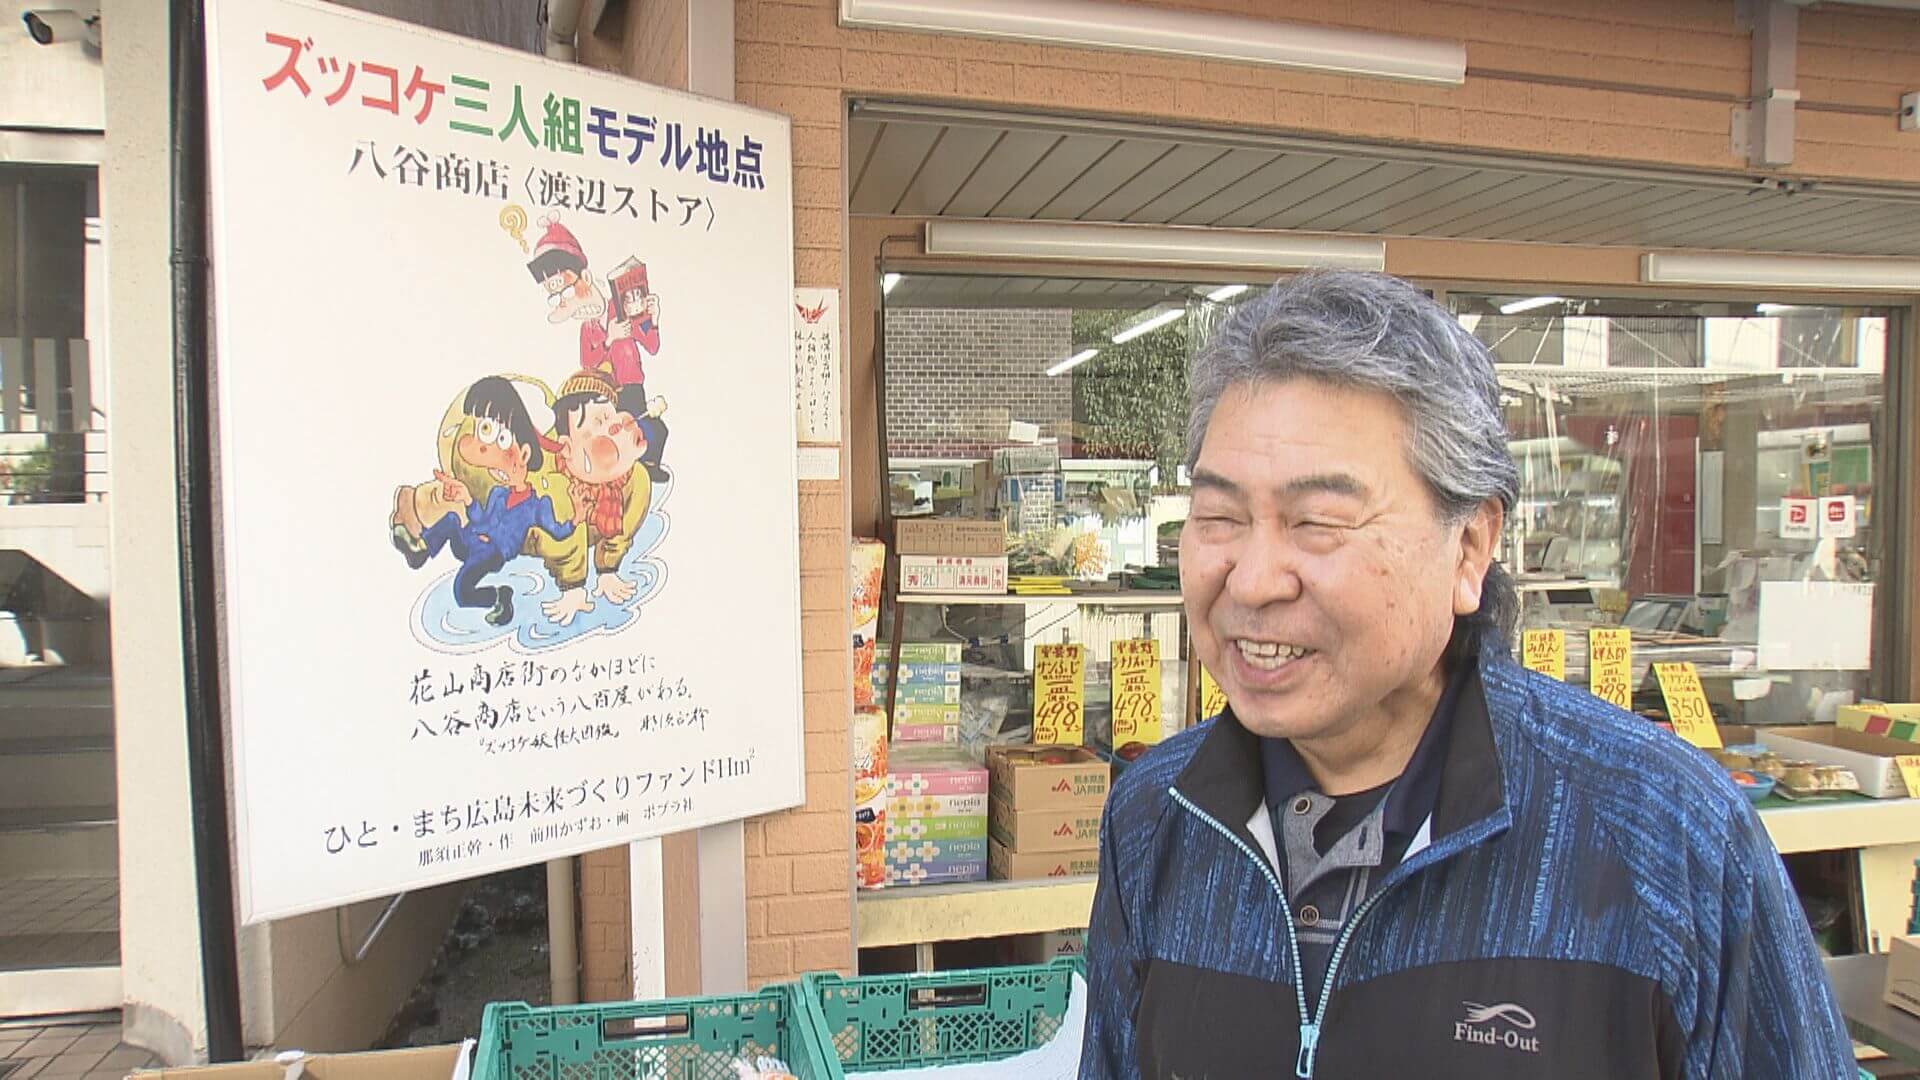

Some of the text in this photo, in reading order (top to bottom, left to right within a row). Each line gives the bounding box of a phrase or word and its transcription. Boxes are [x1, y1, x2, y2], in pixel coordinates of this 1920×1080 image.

[262, 32, 766, 190] ズッコケ三人組モデル地点
[1036, 701, 1080, 727] 498
[1114, 692, 1157, 718] 498
[1670, 697, 1705, 719] 350
[1454, 1022, 1540, 1052] Find-Out
